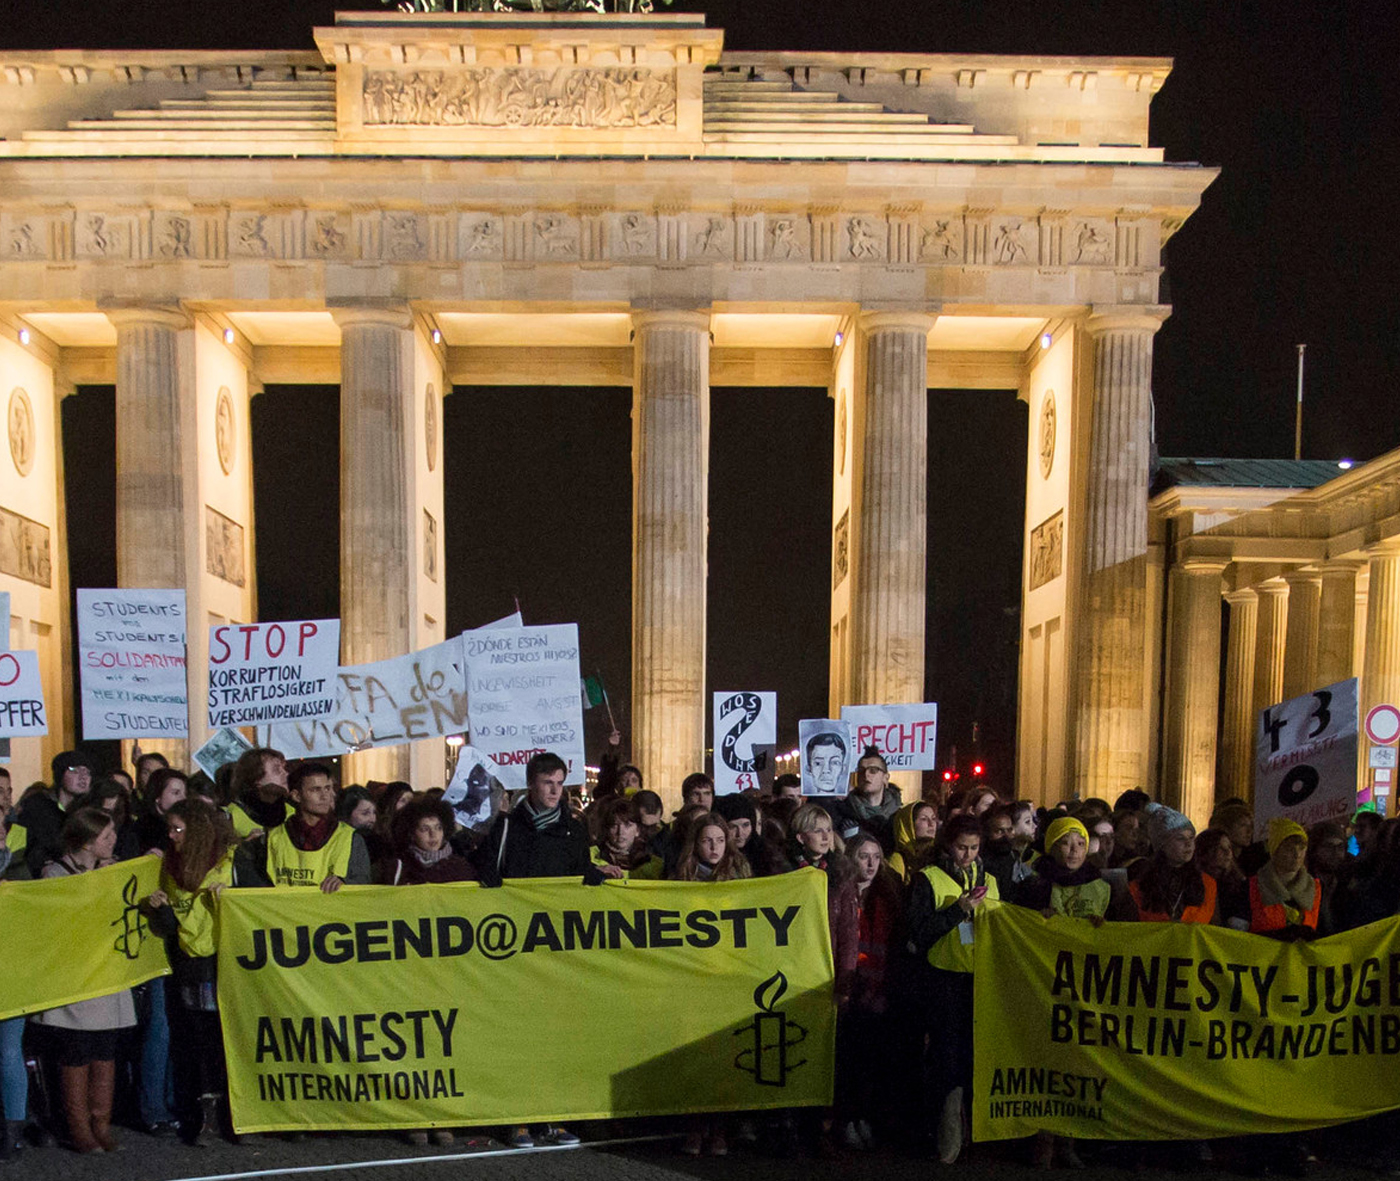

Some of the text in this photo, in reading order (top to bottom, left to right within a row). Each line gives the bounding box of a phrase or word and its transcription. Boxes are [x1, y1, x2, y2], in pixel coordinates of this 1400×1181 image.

[92, 601, 181, 618] STUDENTS
[210, 622, 318, 665] STOP
[209, 665, 301, 689] KORRUPTION
[209, 678, 326, 708] STRAFLOSIGKEIT
[209, 699, 333, 728] VERSCHWINDENLASSEN
[1263, 690, 1332, 752] 43
[735, 773, 753, 791] 43
[236, 905, 801, 970] JUGEND@AMNESTY
[255, 1008, 458, 1063] AMNESTY
[258, 1068, 464, 1102] INTERNATIONAL
[990, 1068, 1107, 1102] AMNESTY
[989, 1100, 1105, 1122] INTERNATIONAL
